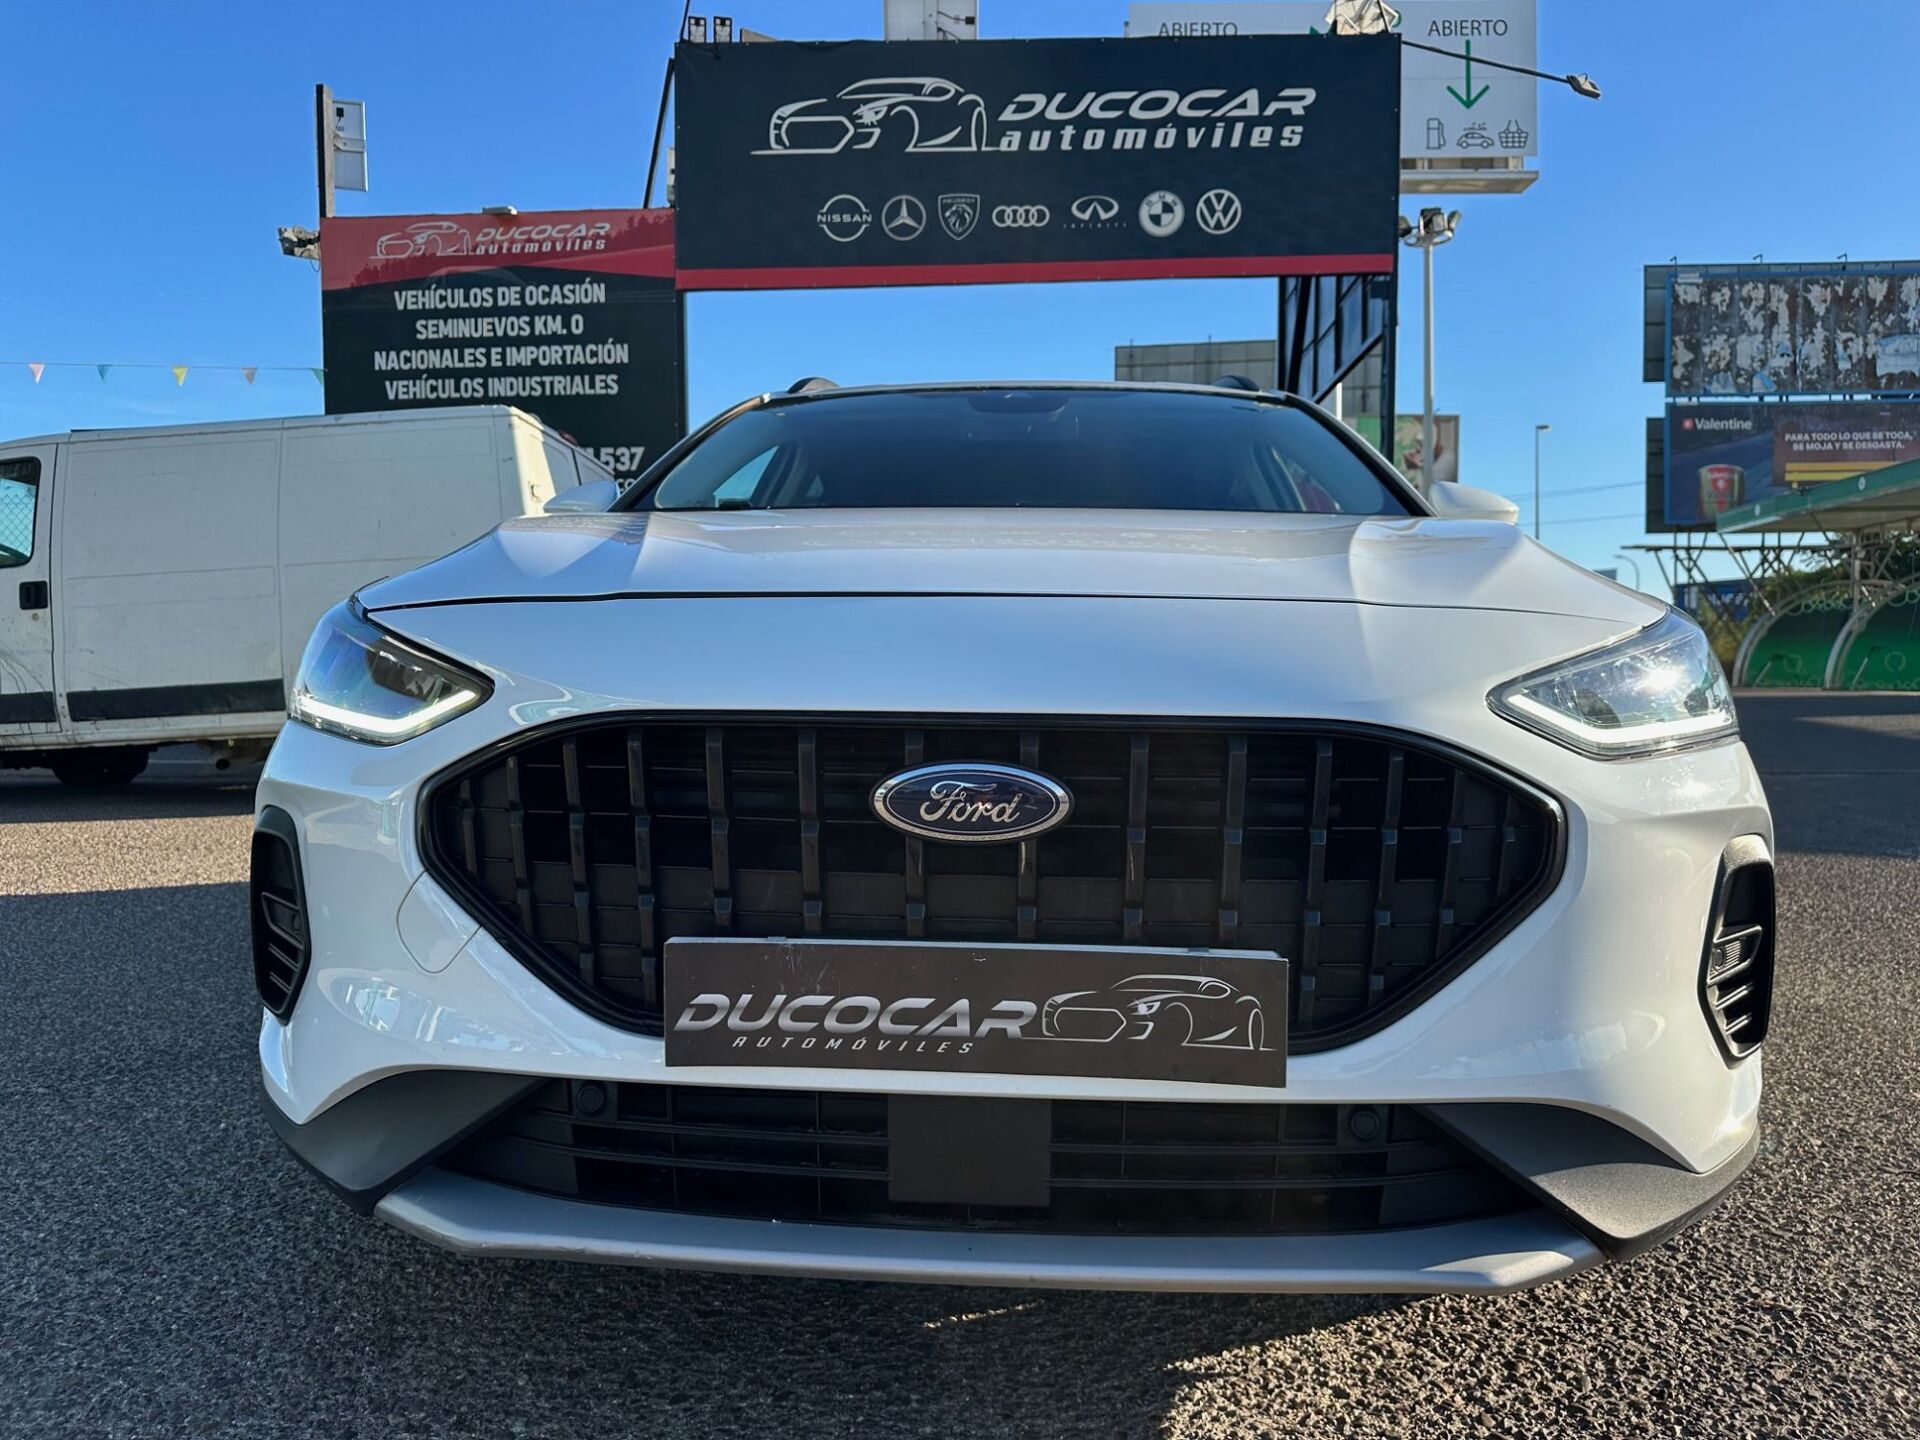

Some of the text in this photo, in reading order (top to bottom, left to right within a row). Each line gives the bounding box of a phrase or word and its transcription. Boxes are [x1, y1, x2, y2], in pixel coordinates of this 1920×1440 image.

[1159, 22, 1238, 37] ABIERTO
[1428, 19, 1508, 37] ABIERTO
[998, 88, 1317, 121] DUCOCAR
[999, 122, 1304, 152] automóviles
[817, 213, 872, 223] NISSAN
[475, 223, 611, 241] DUCOCAR
[394, 278, 606, 310] VEHÍCULOS DE OCASIÓN
[415, 316, 530, 340] SEMINUEVOS
[534, 315, 567, 335] KM.
[374, 338, 629, 370] NACIONALES E IMPORTACIÓN
[385, 373, 619, 400] VEHÍCULOS INDUSTRIALES
[1695, 418, 1752, 430] Valentine
[1785, 433, 1809, 441] PARA
[1811, 432, 1838, 441] TODO
[1839, 432, 1850, 441] LO
[1852, 432, 1871, 441] QUE
[1806, 442, 1834, 451] MOJA
[1835, 442, 1842, 450] Y
[920, 780, 1022, 822] Ford
[673, 993, 1038, 1039] DUCOCAR
[732, 1035, 974, 1054] AUTOMÓVILES
